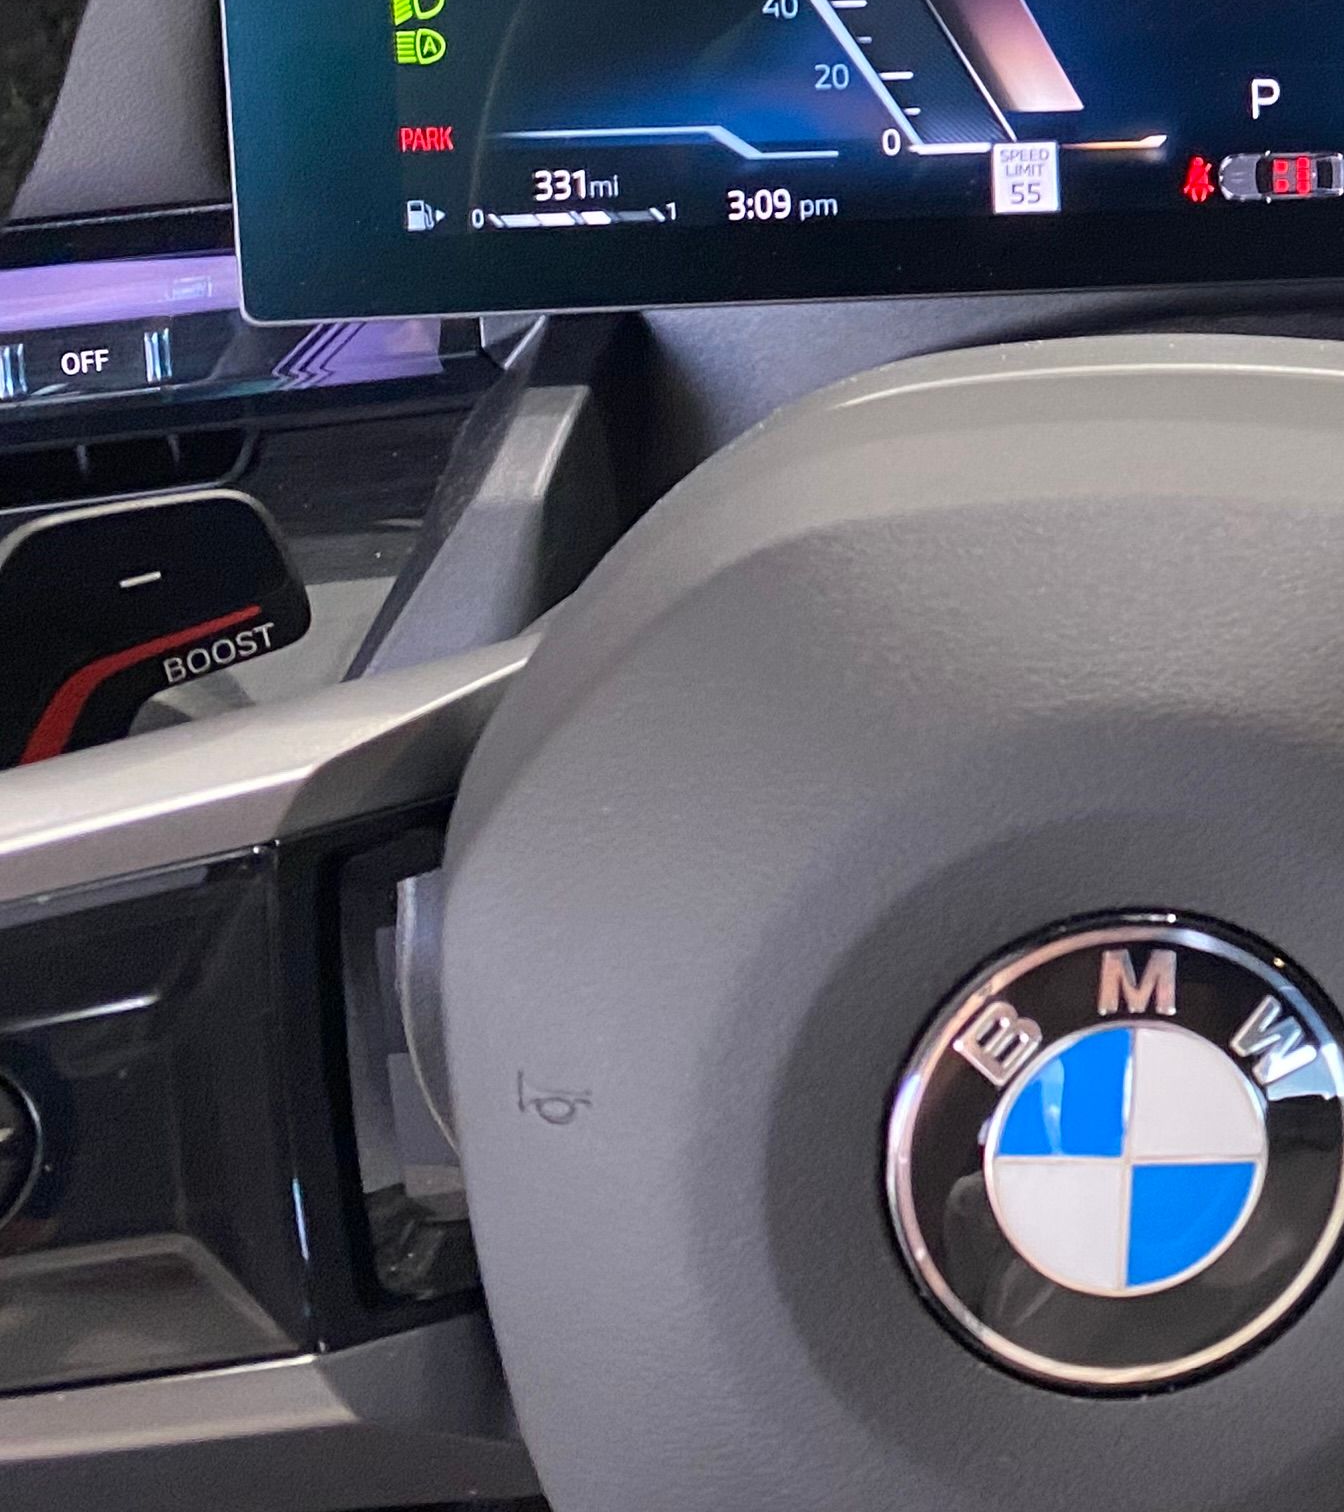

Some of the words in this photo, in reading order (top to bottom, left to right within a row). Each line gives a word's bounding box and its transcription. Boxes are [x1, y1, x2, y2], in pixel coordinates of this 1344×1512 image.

[814, 64, 850, 89] 20
[1251, 78, 1281, 120] P
[400, 126, 454, 152] PARK
[881, 129, 901, 156] 0
[999, 149, 1050, 163] SPEED
[1004, 165, 1044, 177] LIMIT
[727, 188, 792, 221] 3:09
[800, 198, 839, 222] pm
[1010, 183, 1042, 205] 55
[471, 211, 484, 230] 0
[666, 203, 677, 221] 1
[60, 349, 109, 375] OFF
[163, 622, 275, 684] BOOST
[952, 948, 1319, 1088] BMW
